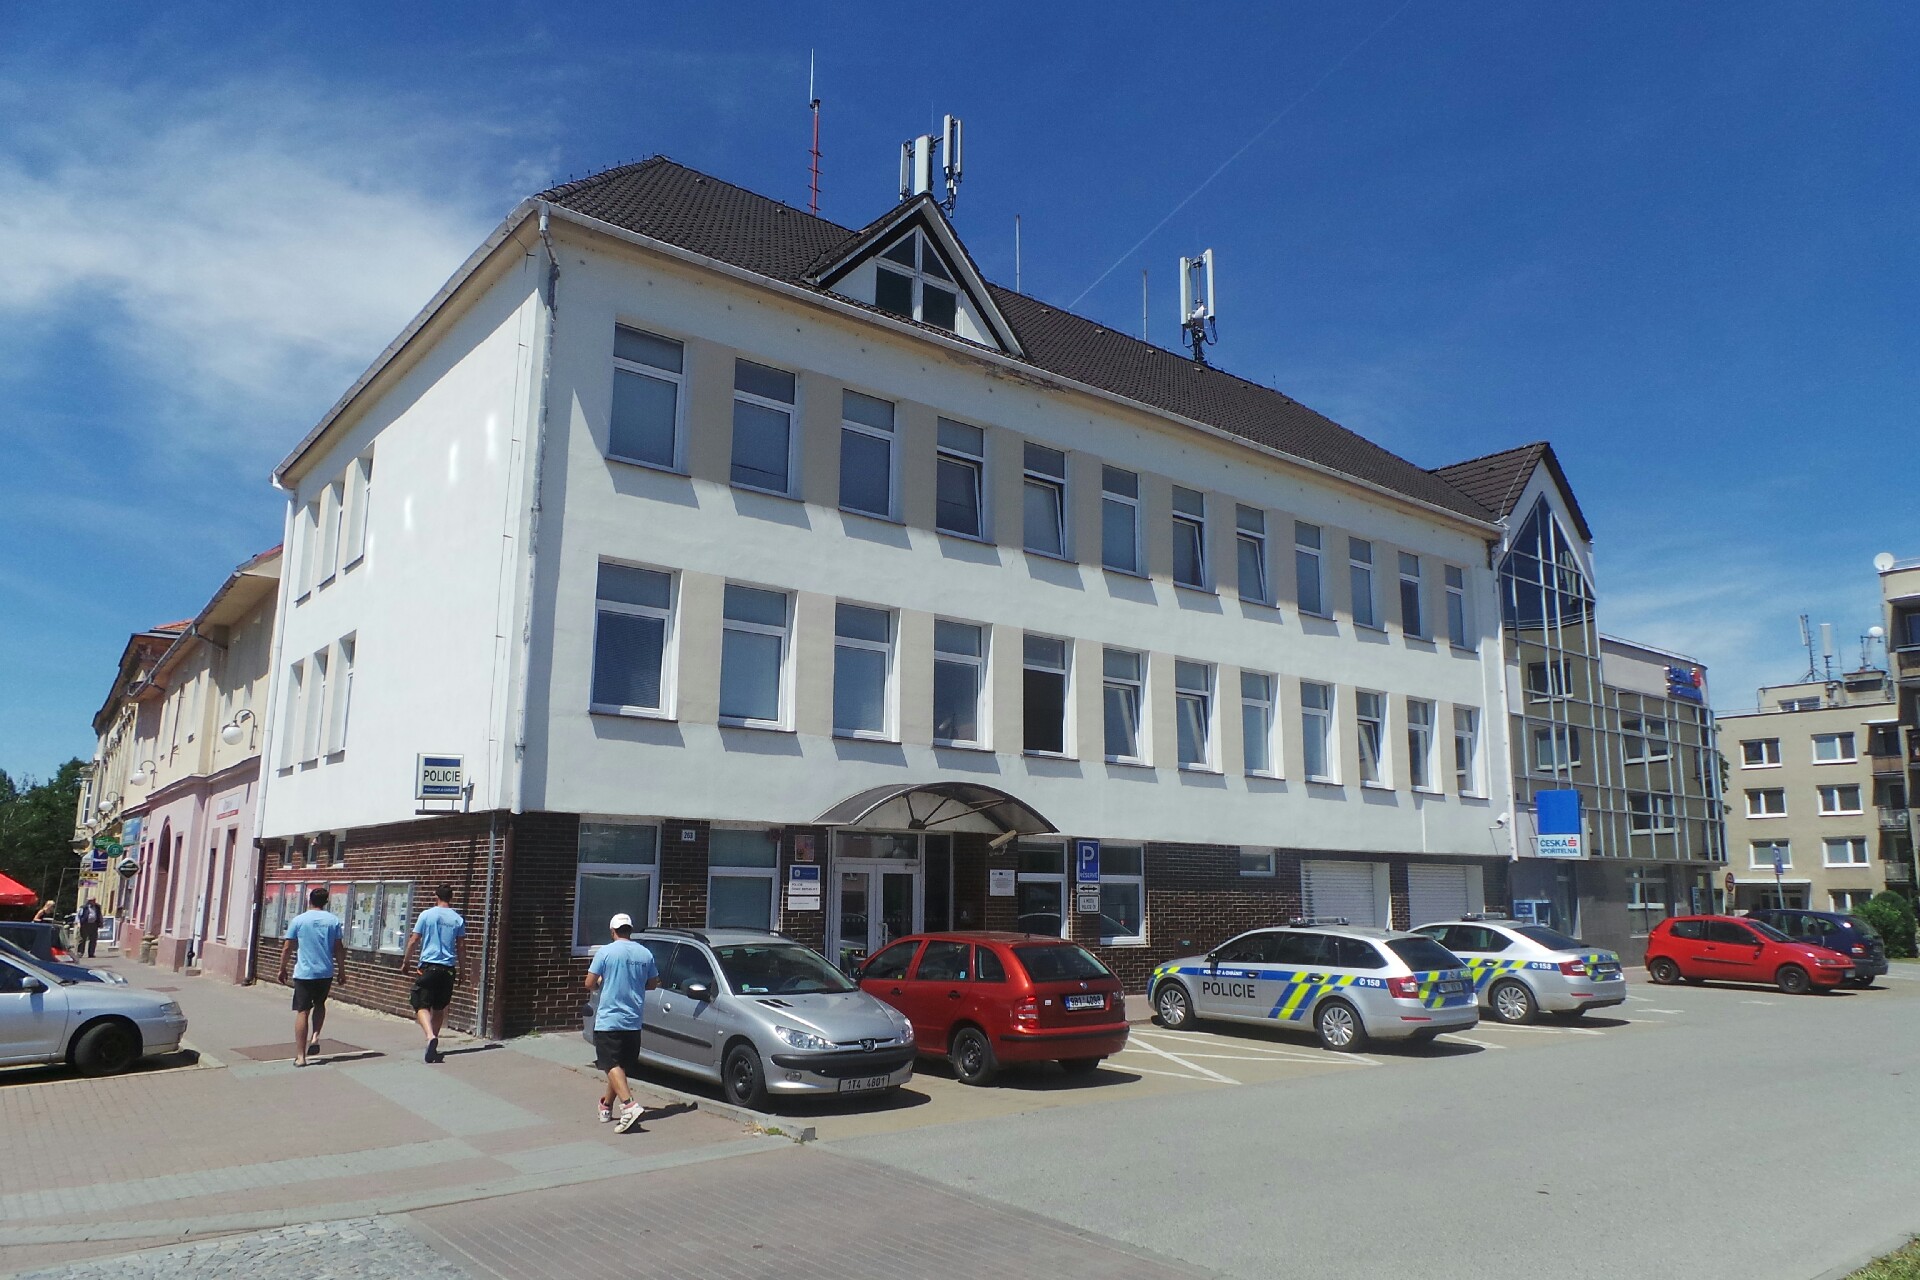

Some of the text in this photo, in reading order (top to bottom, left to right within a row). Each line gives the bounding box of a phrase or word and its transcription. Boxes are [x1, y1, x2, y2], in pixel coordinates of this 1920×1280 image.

[423, 770, 460, 782] POLICIE
[1540, 837, 1568, 847] ČESKÁ
[1082, 845, 1095, 870] P
[1538, 962, 1552, 970] 158
[1366, 978, 1380, 987] 158
[1202, 981, 1256, 999] POLICIE
[847, 1079, 861, 1090] 1T4
